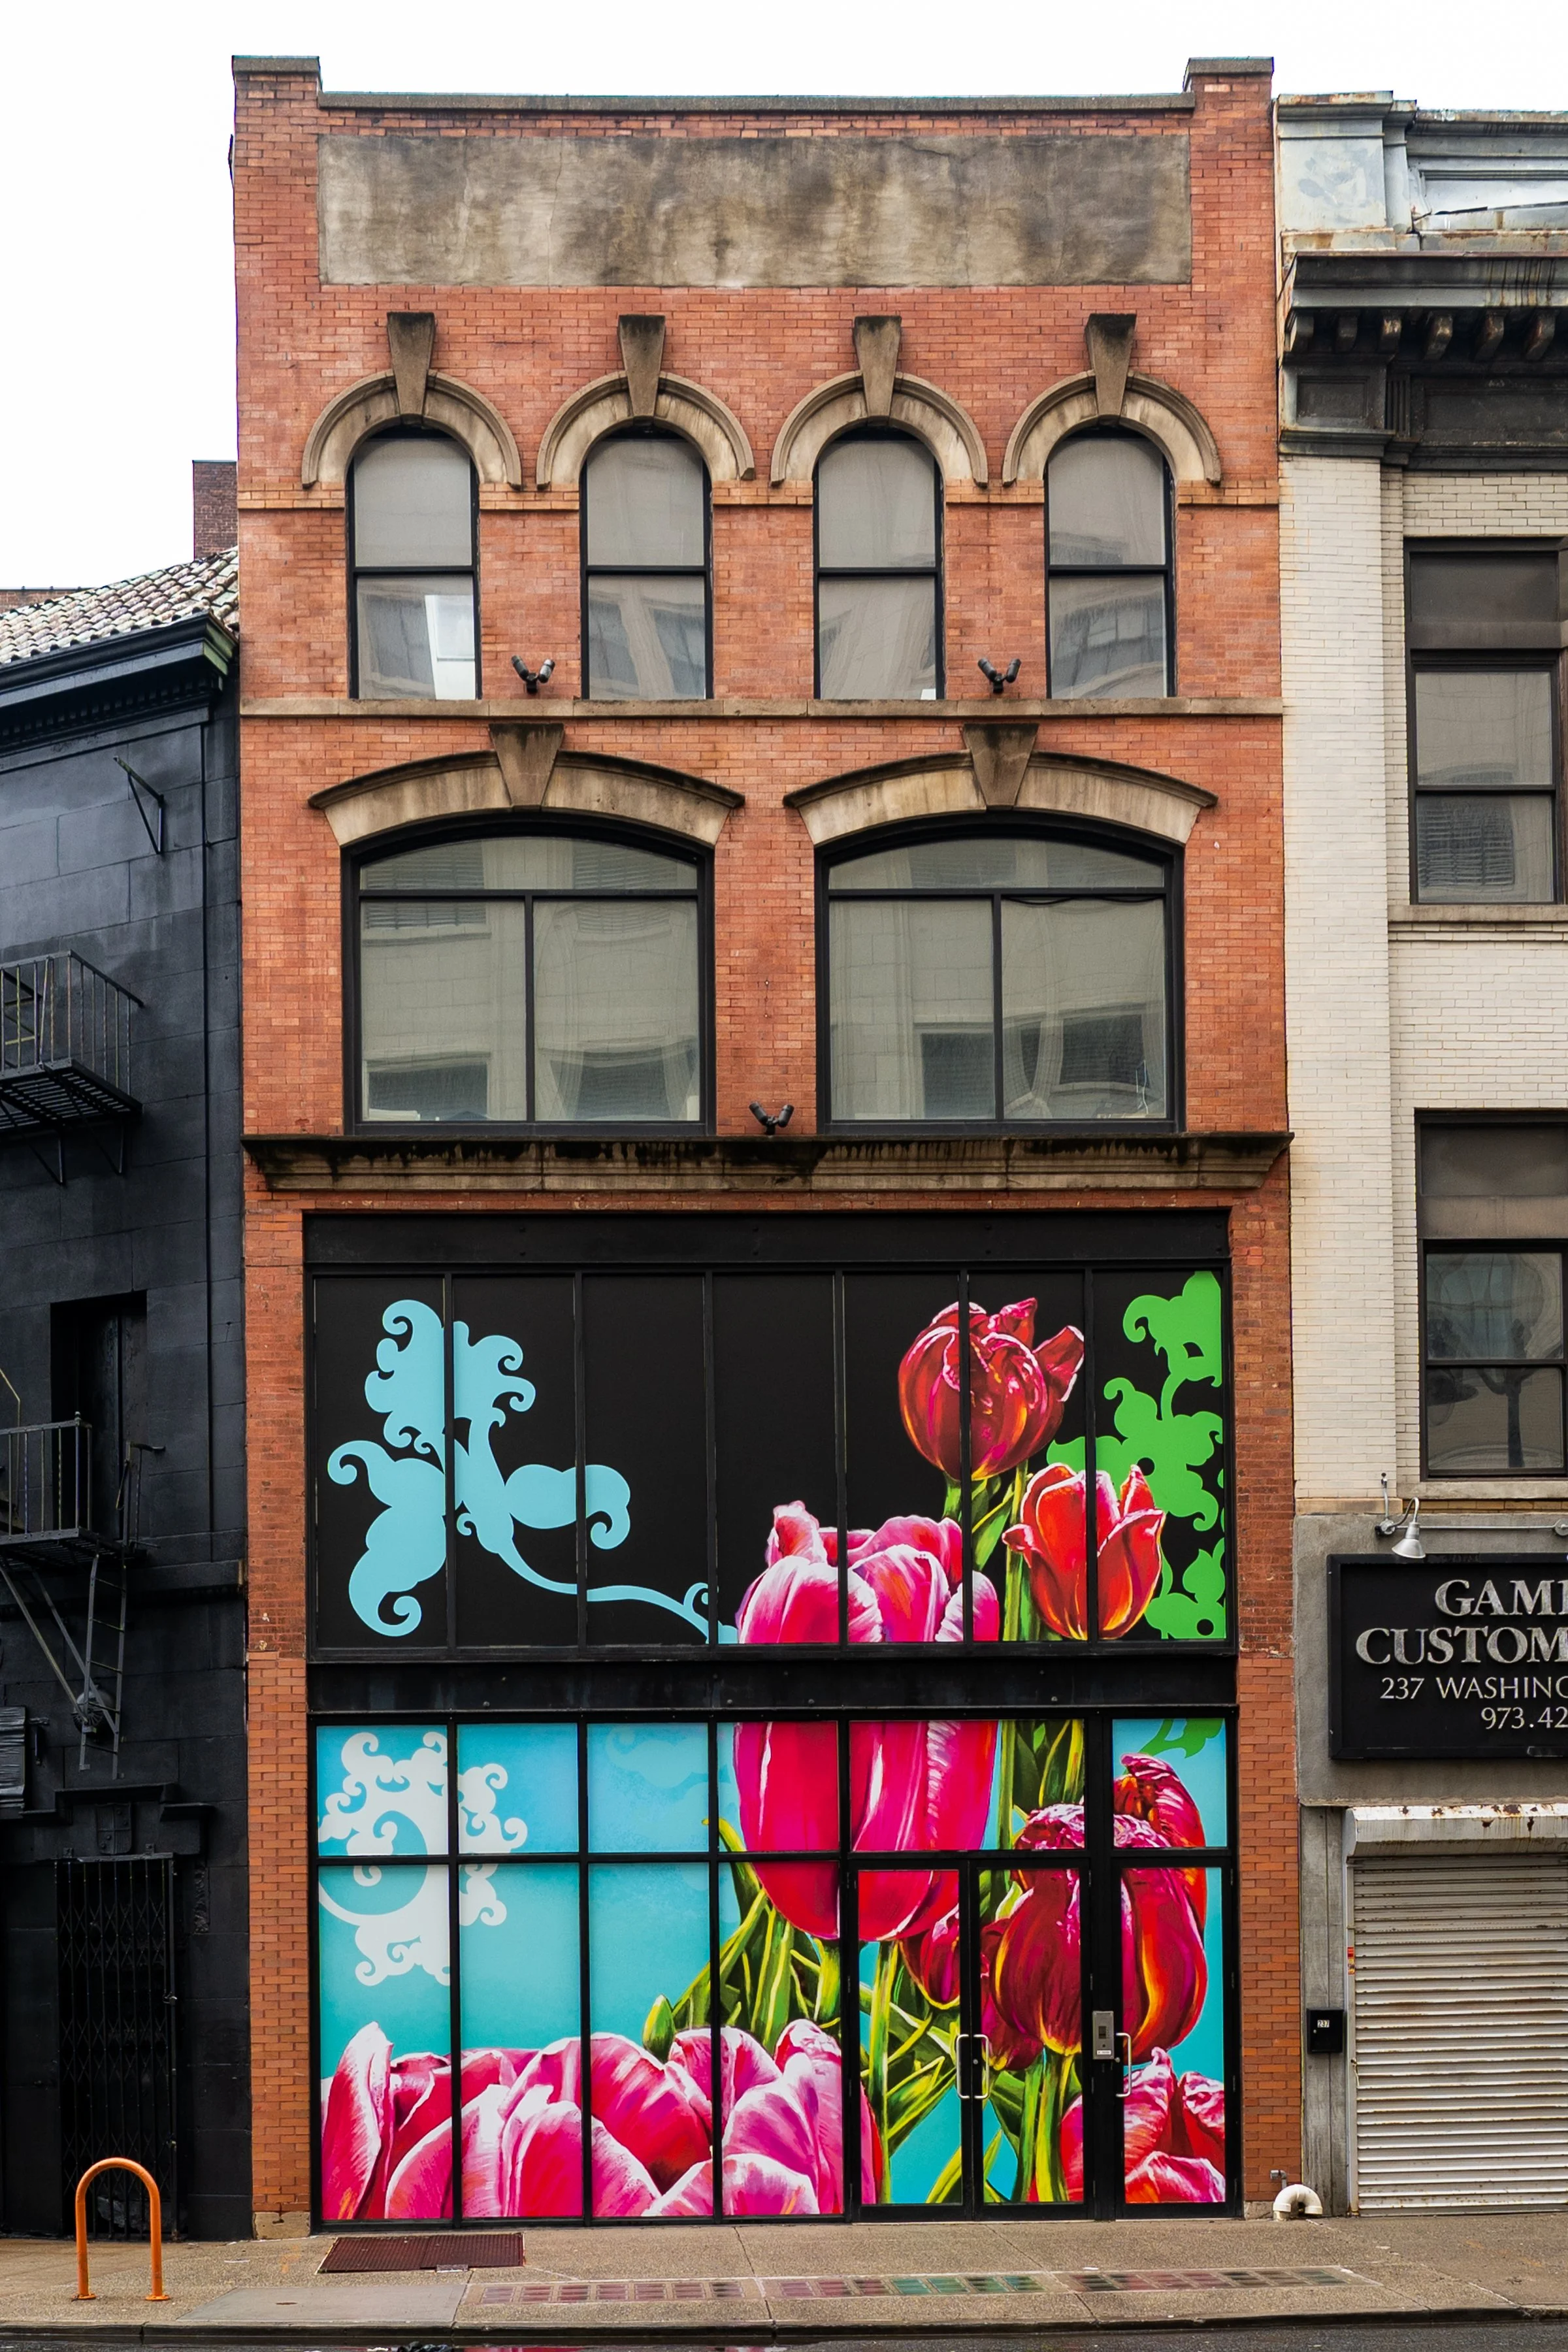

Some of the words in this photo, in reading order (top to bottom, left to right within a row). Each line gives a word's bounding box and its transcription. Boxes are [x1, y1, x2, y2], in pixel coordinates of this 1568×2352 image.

[1356, 1625, 1568, 1664] CUSTOM
[1380, 1678, 1424, 1699] 237
[1481, 1707, 1568, 1729] 973.42
